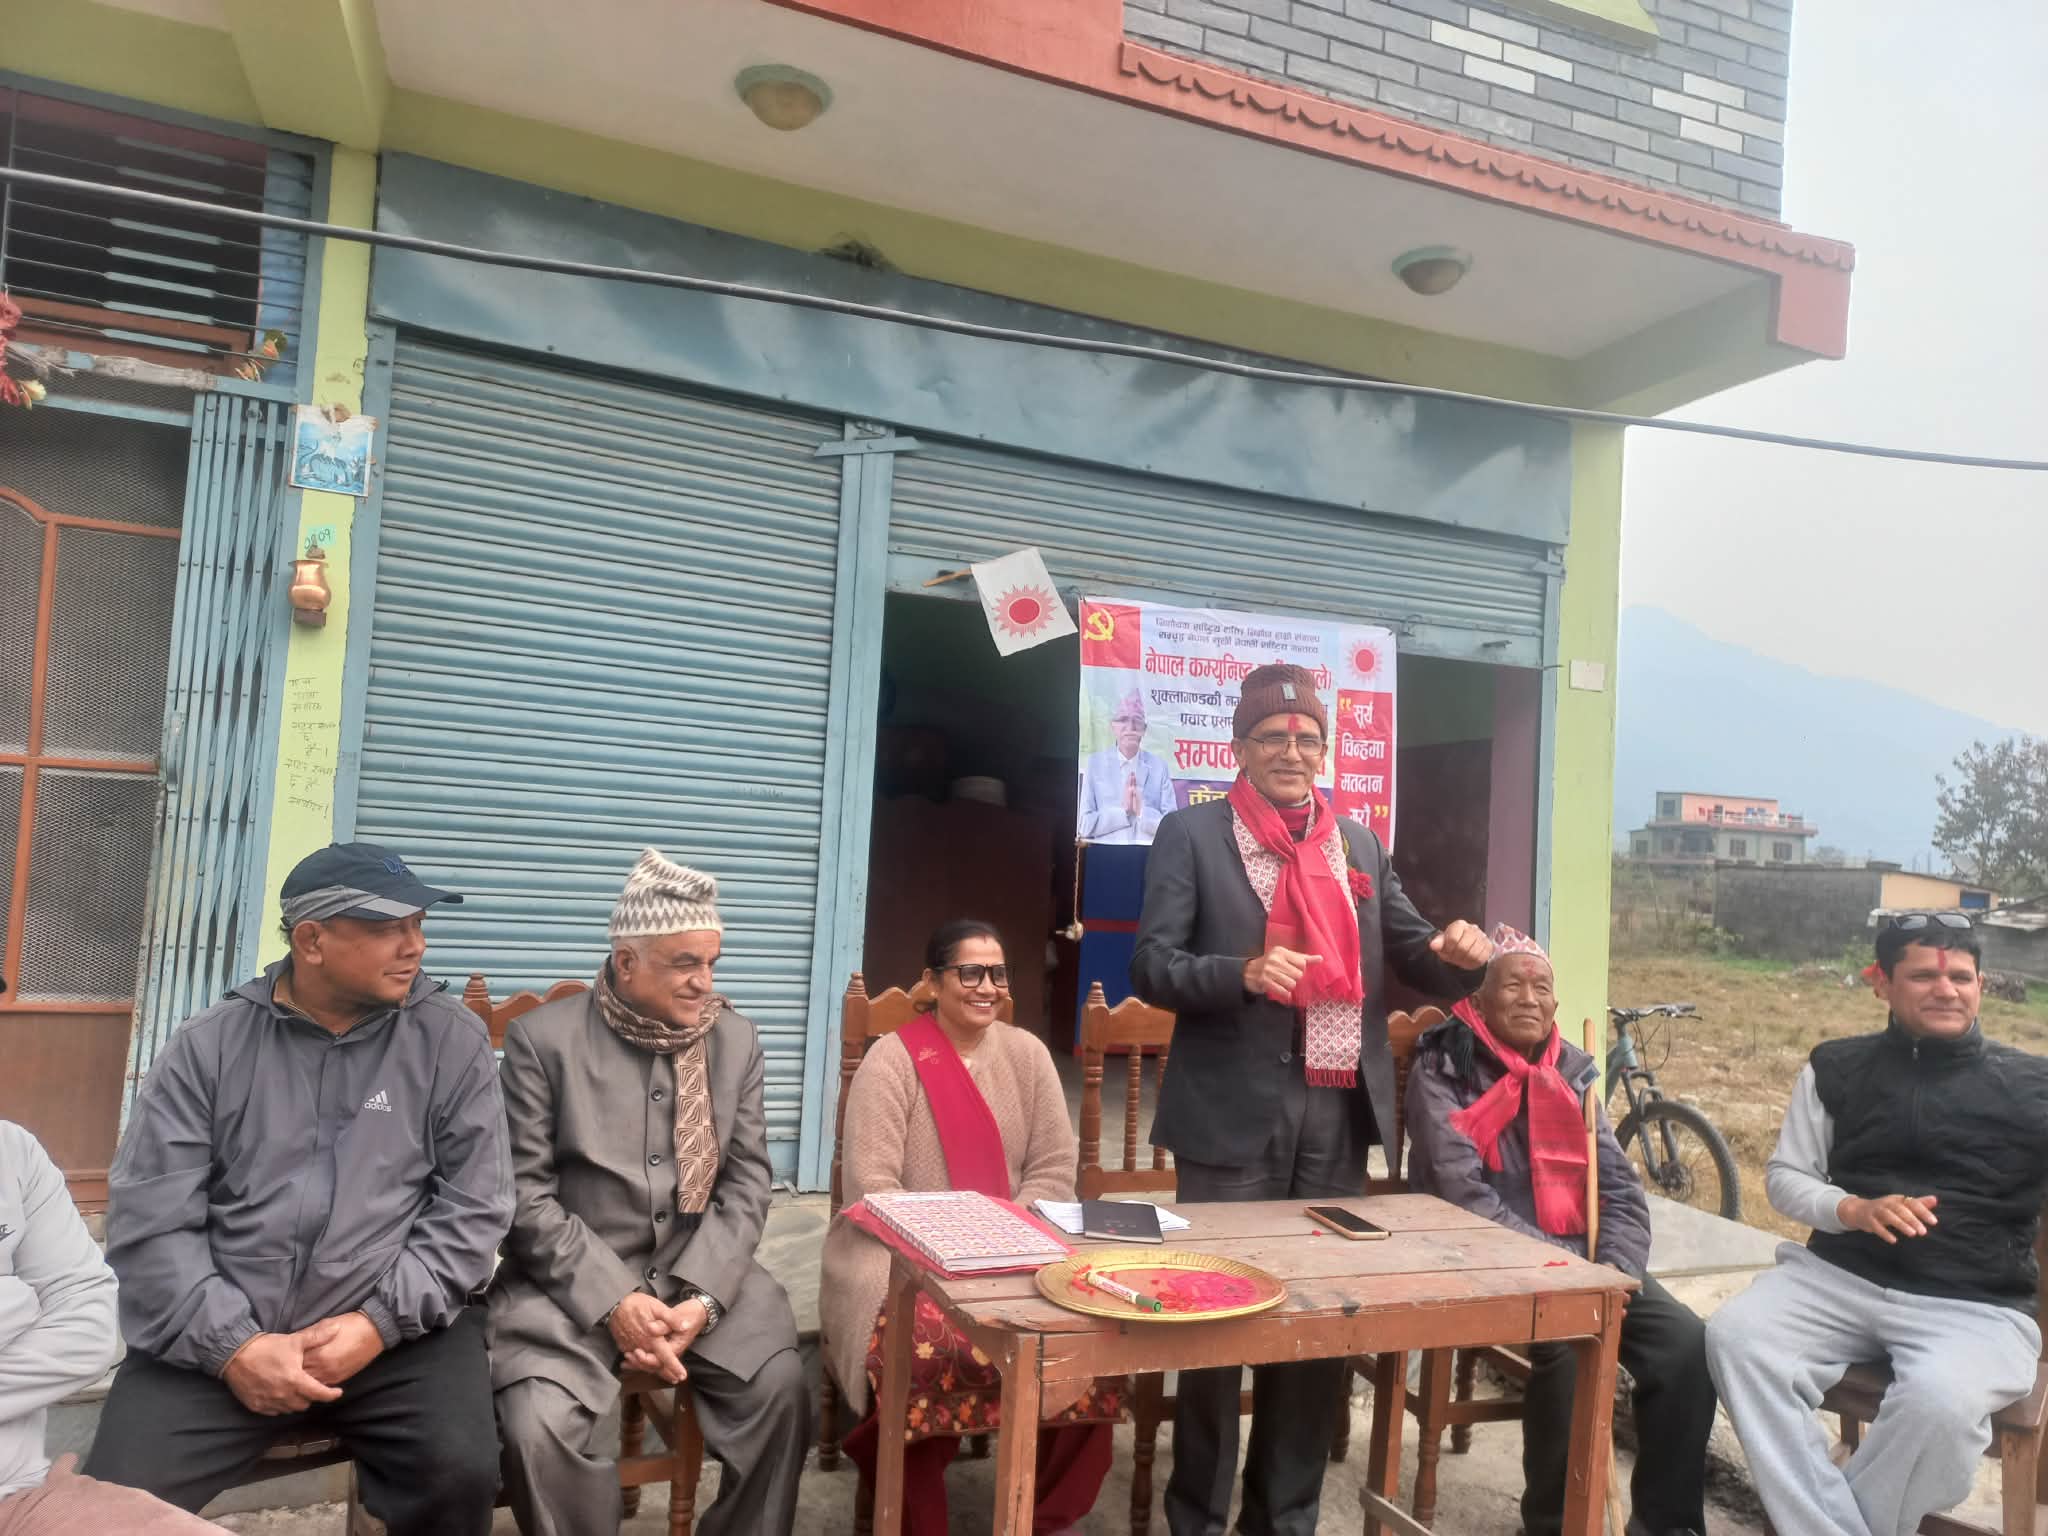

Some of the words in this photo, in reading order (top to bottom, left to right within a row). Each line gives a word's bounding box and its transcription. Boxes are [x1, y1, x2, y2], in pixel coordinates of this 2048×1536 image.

[1145, 646, 1186, 677] नेपाल
[1180, 713, 1209, 728] प्रचार
[1340, 773, 1385, 795] मतदान
